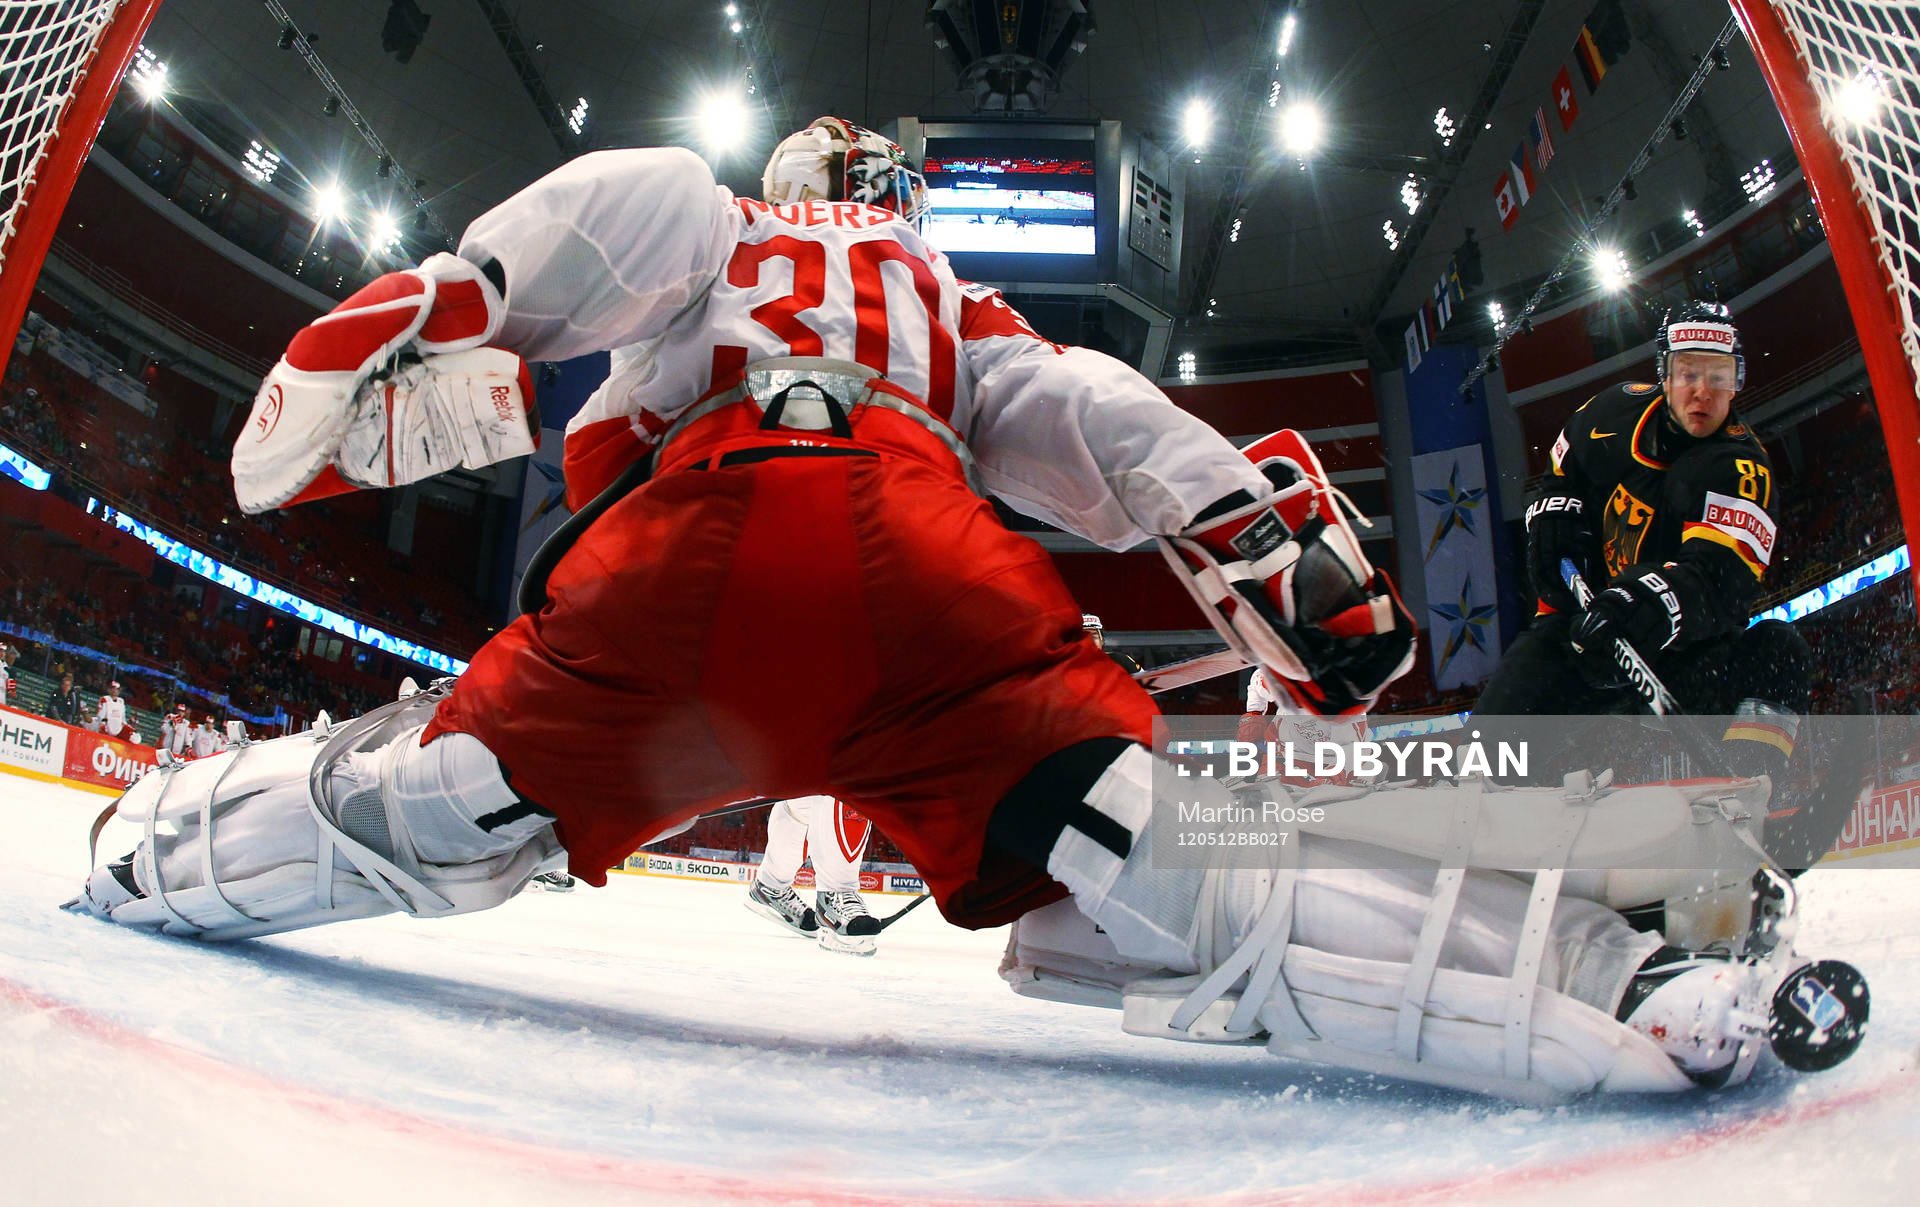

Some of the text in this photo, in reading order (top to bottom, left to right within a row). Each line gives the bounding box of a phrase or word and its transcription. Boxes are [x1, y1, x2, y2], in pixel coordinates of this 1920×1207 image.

[733, 197, 895, 229] NDERS
[711, 234, 957, 421] 30
[1670, 329, 1732, 343] BAUHAUS
[489, 386, 517, 422] Reebok
[1735, 458, 1771, 509] 87
[1707, 505, 1773, 549] BAUHAUS
[0, 719, 52, 753] HEM
[687, 862, 729, 876] ŠKODA
[892, 878, 921, 887] NIVEA
